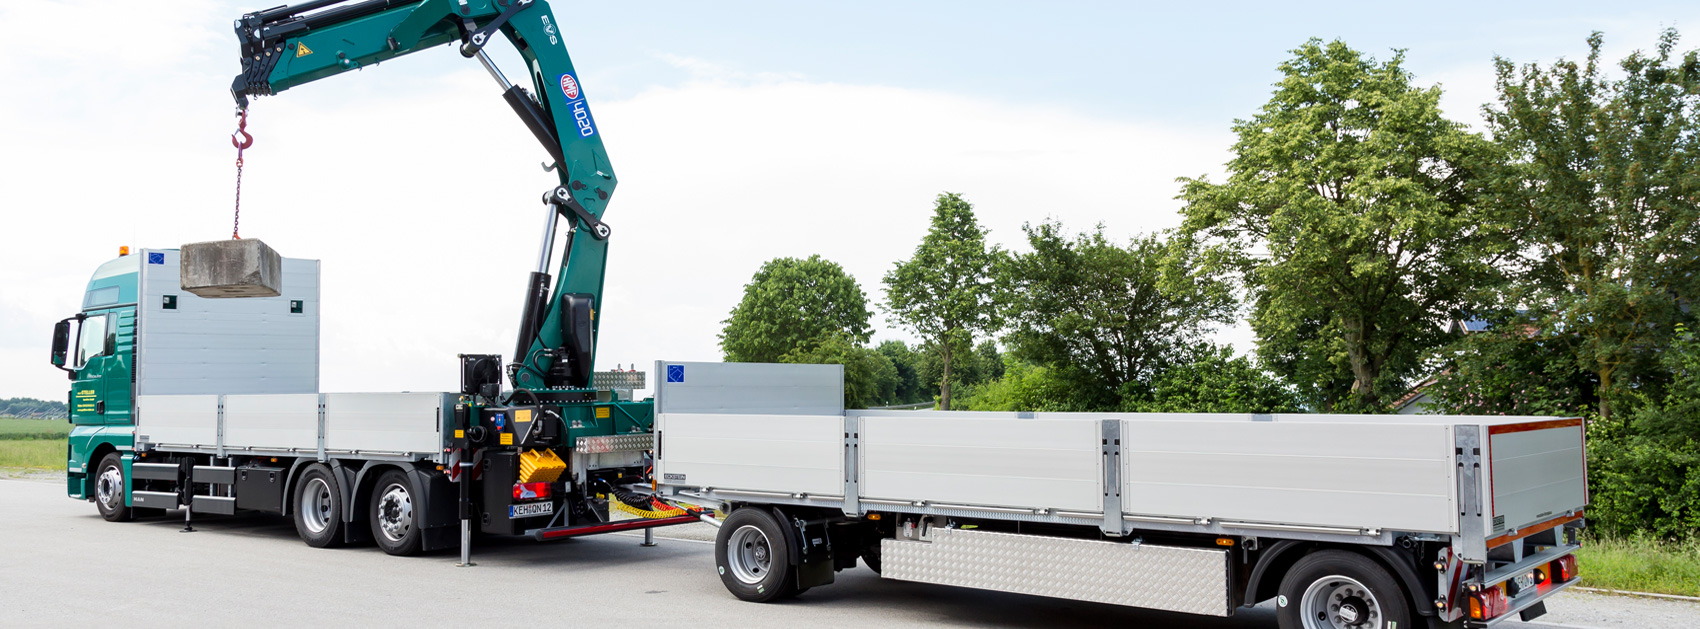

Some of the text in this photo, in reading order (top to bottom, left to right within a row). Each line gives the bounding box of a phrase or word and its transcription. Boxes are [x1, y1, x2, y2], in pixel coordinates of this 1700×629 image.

[562, 76, 577, 97] HMF
[573, 101, 593, 137] 4020
[513, 505, 529, 515] KEH
[543, 503, 552, 512] 12
